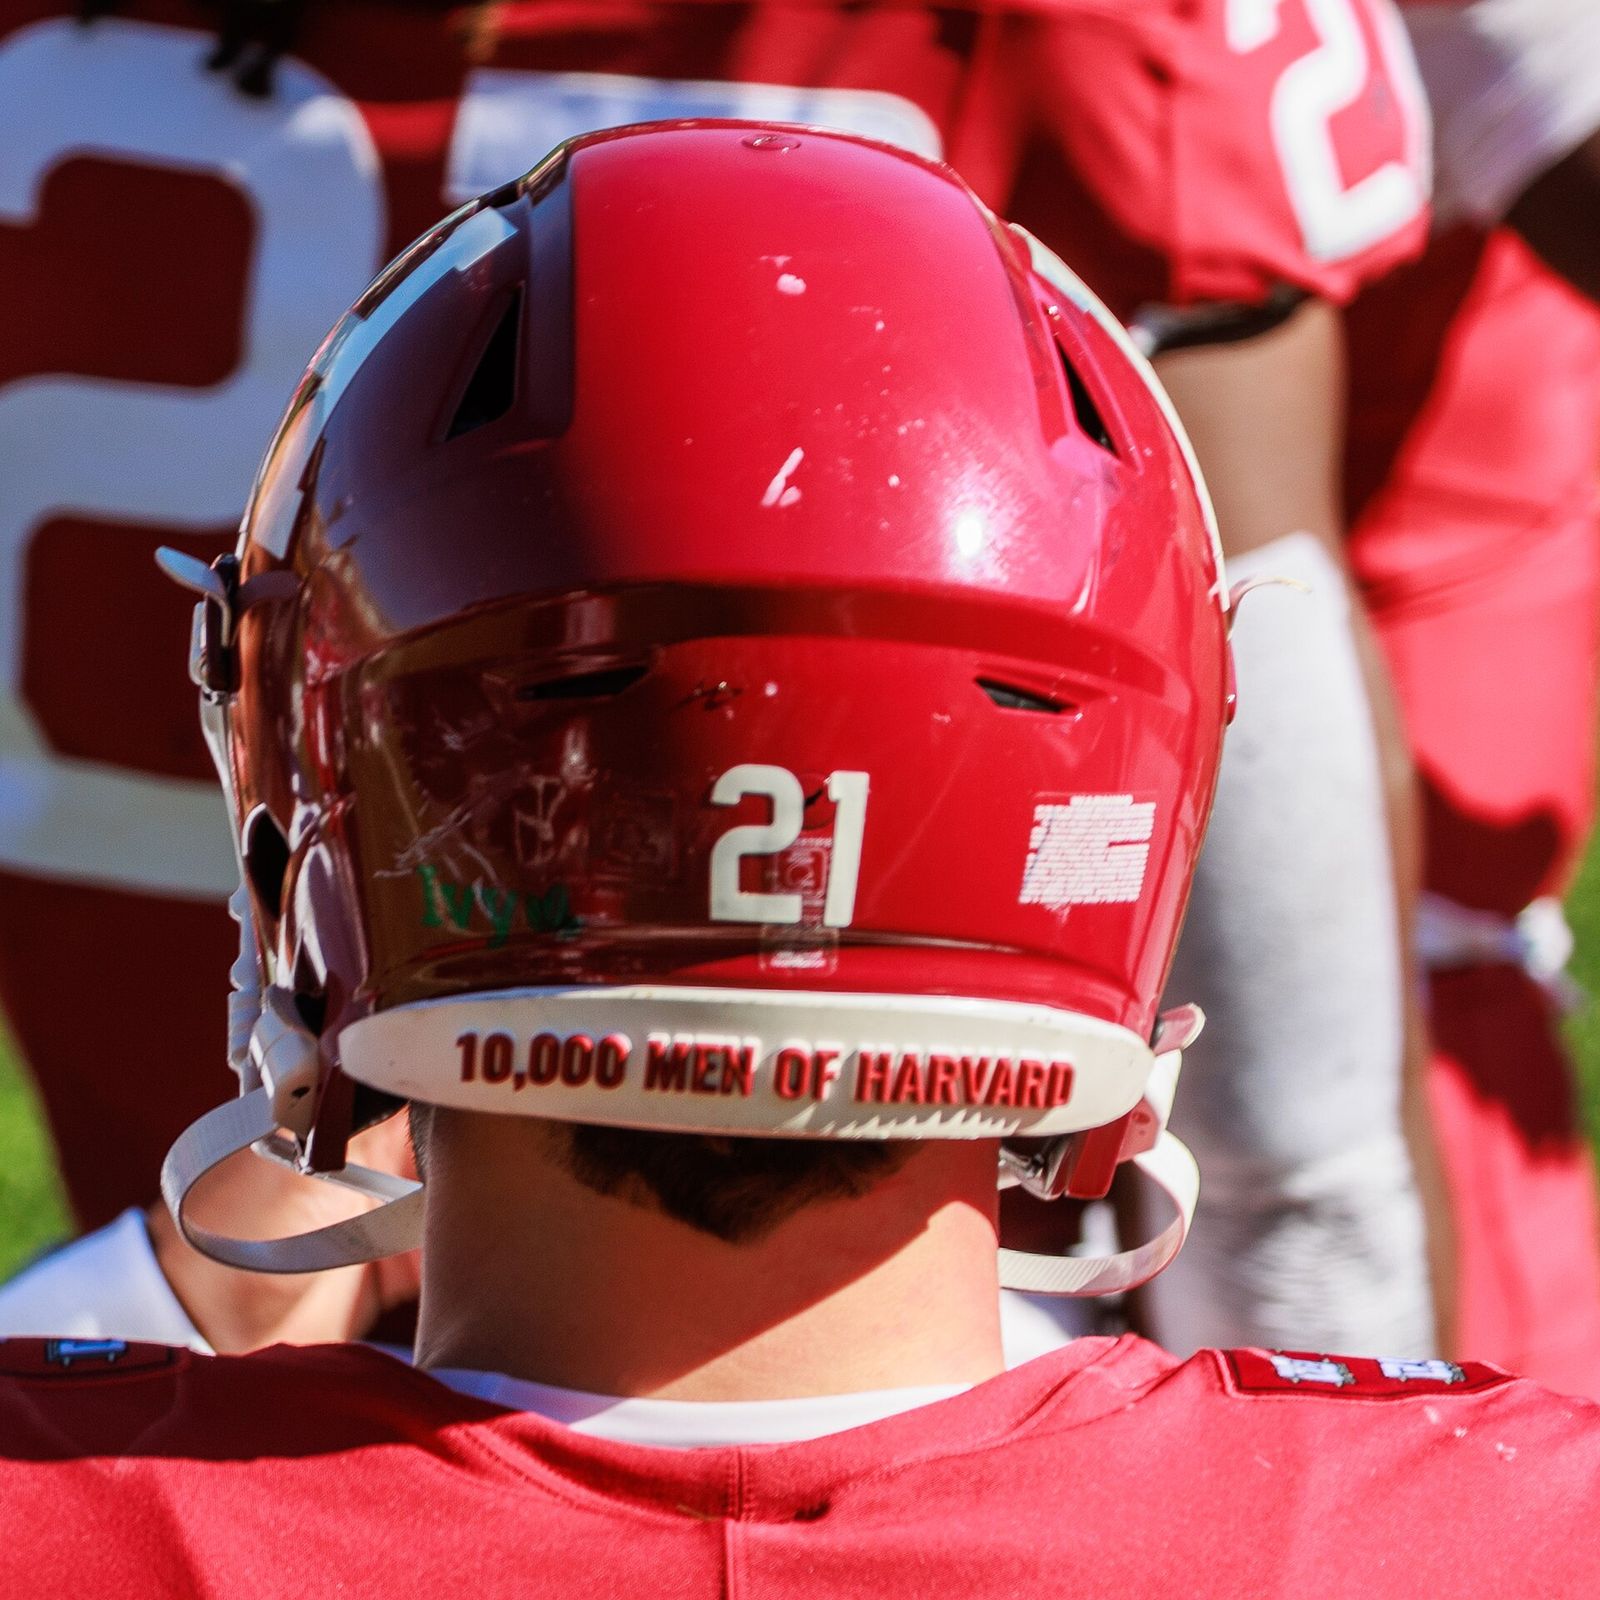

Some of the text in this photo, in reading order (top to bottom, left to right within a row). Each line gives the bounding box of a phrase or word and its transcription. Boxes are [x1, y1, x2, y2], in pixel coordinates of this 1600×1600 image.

[1225, 0, 1434, 264] 2
[416, 864, 519, 949] Ivy
[709, 763, 870, 928] 21
[455, 1031, 1075, 1110] 10,000 MEN OF HARVARD
